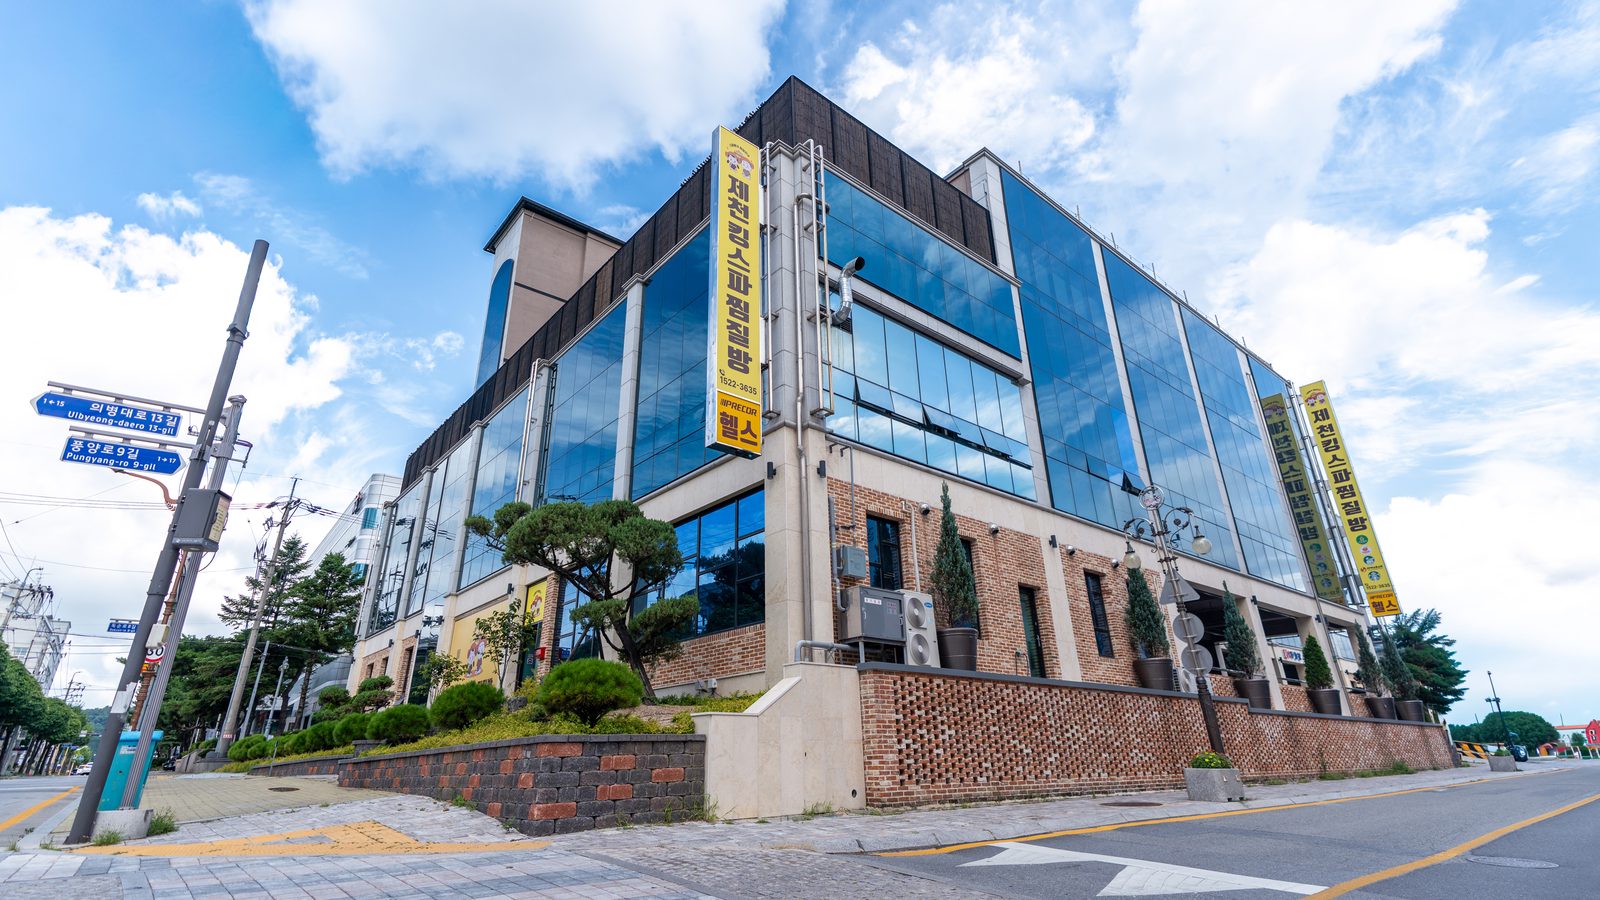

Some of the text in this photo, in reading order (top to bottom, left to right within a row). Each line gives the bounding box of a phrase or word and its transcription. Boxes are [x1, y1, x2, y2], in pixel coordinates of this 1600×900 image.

[726, 174, 752, 375] 제천킹스파찜질방
[719, 376, 758, 395] 1522-3635
[725, 400, 758, 416] PRECOR
[148, 424, 174, 435] 13-gil
[719, 410, 758, 447] 헬스
[66, 452, 156, 471] Pungyang-ro 9-gil
[1311, 407, 1368, 532] 제천킹스파찜질방
[1372, 600, 1398, 613] 헬스
